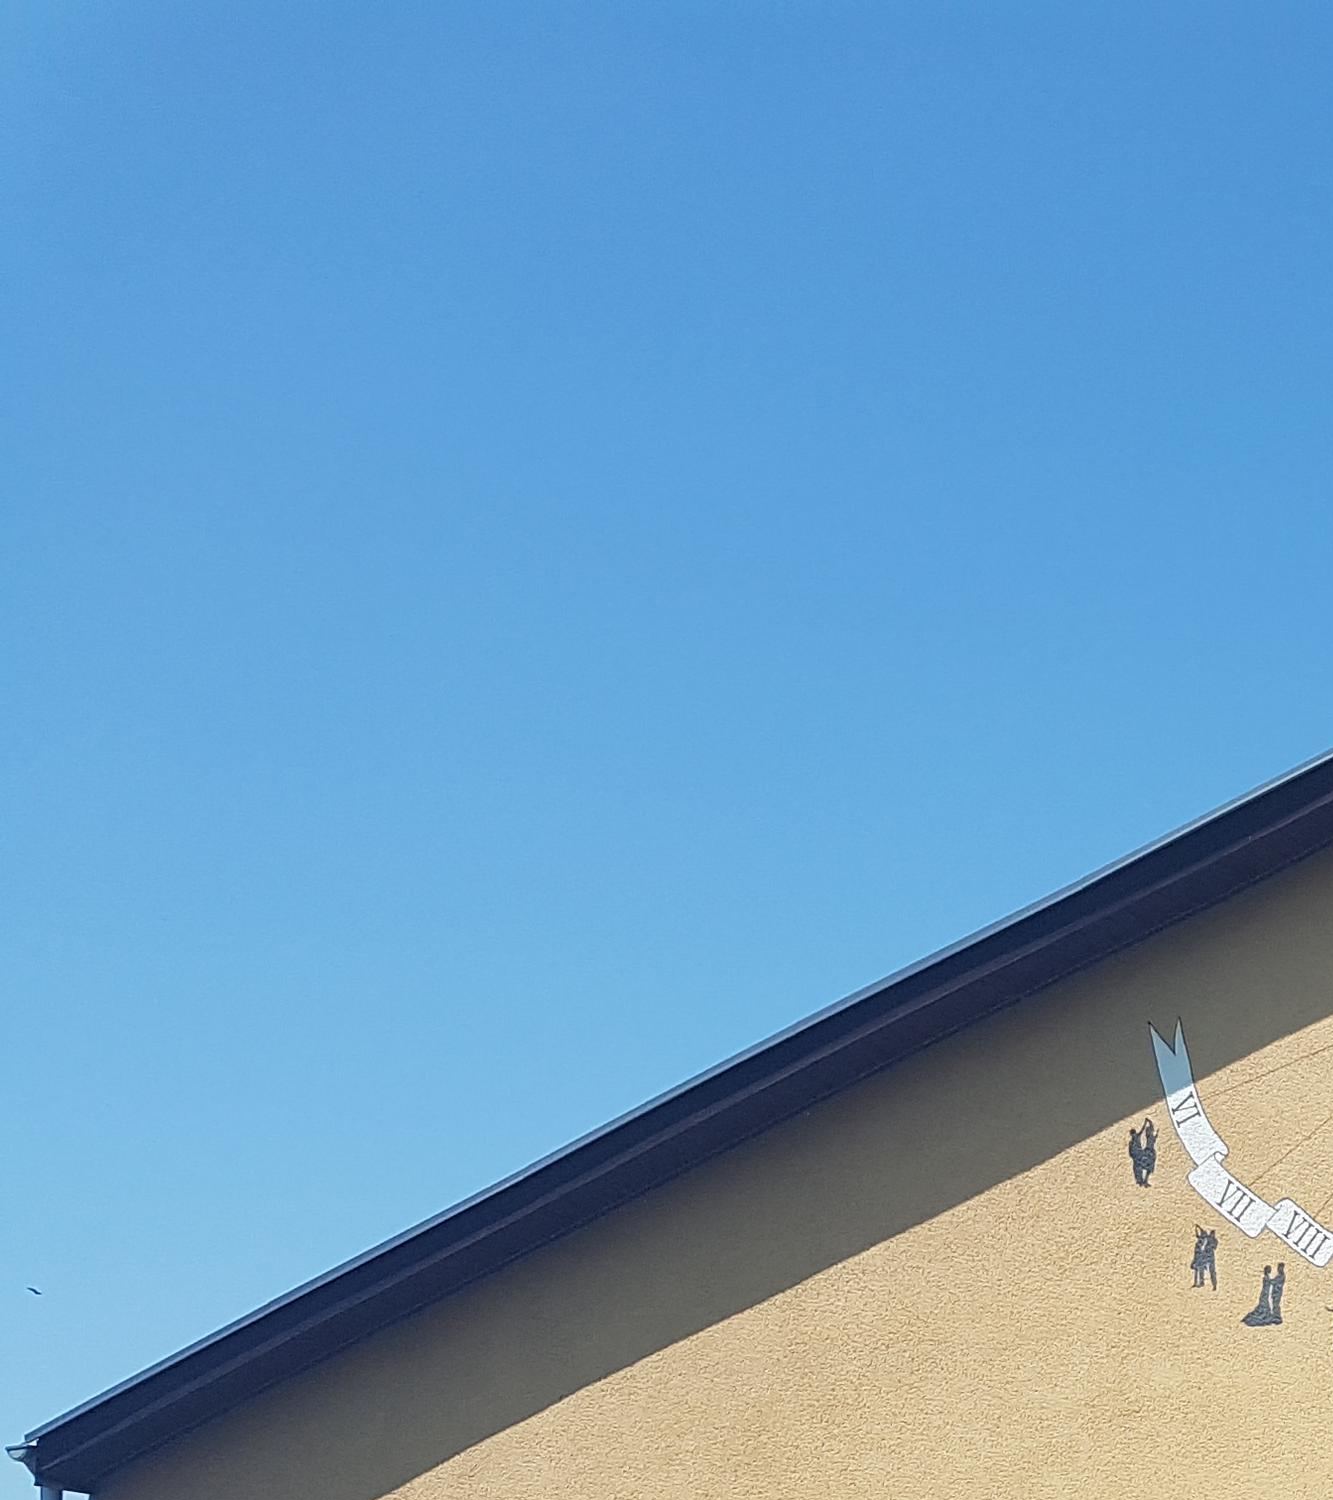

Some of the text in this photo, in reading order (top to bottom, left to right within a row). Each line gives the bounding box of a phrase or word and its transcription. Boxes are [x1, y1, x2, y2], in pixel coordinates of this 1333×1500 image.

[1171, 1090, 1202, 1129] VI
[1215, 1178, 1257, 1223] VII
[1281, 1210, 1331, 1260] VIII
